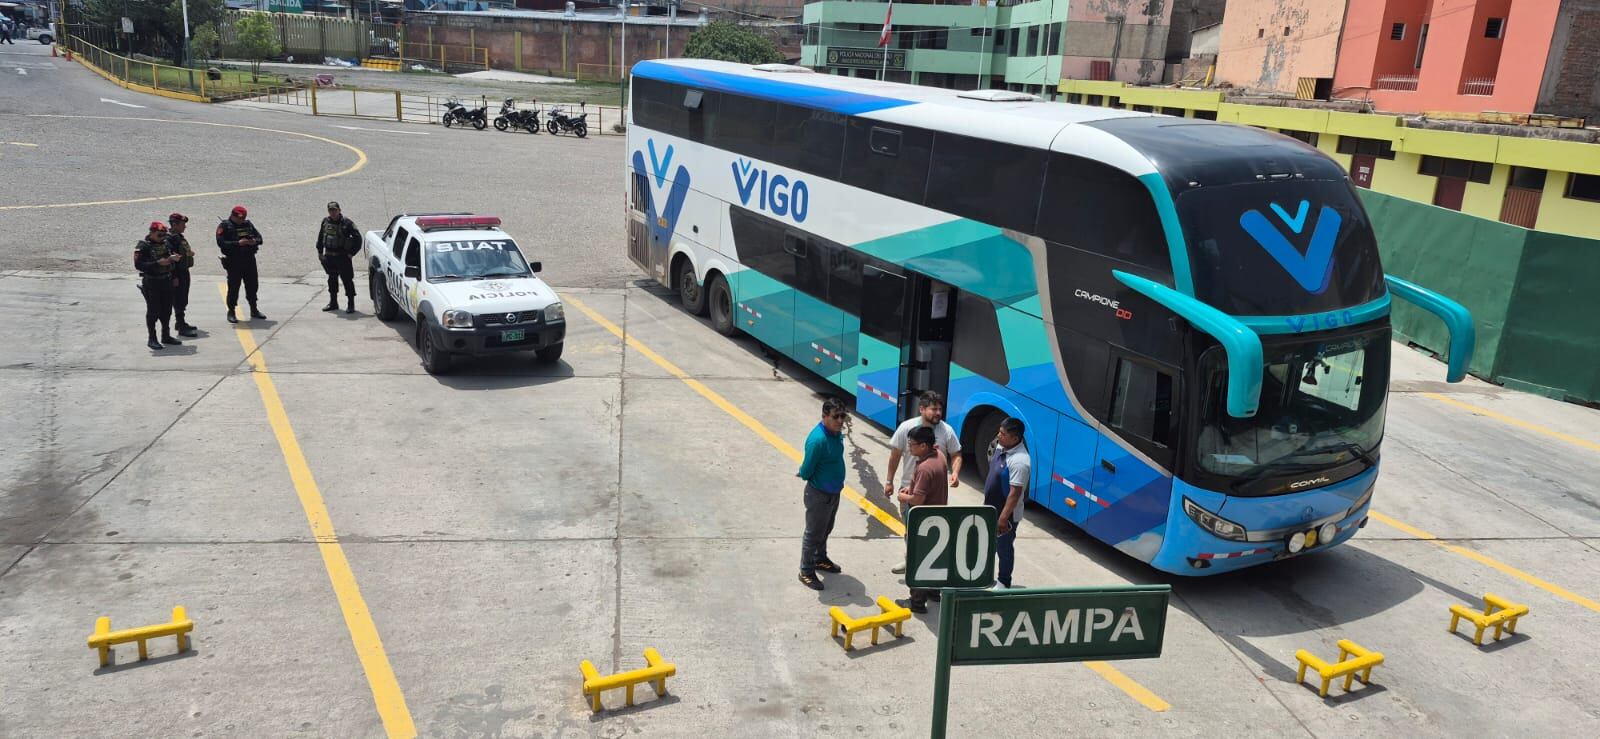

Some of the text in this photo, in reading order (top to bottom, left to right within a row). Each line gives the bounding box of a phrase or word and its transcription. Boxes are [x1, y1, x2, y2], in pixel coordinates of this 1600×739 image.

[270, 0, 302, 8] SALIDA
[731, 158, 809, 223] VIGO
[436, 241, 507, 253] SUAT
[1074, 289, 1121, 309] CAMPIONE
[1285, 310, 1353, 333] VIGO
[1290, 476, 1330, 489] COMIL
[914, 514, 990, 581] 20
[969, 606, 1146, 649] RAMPA
